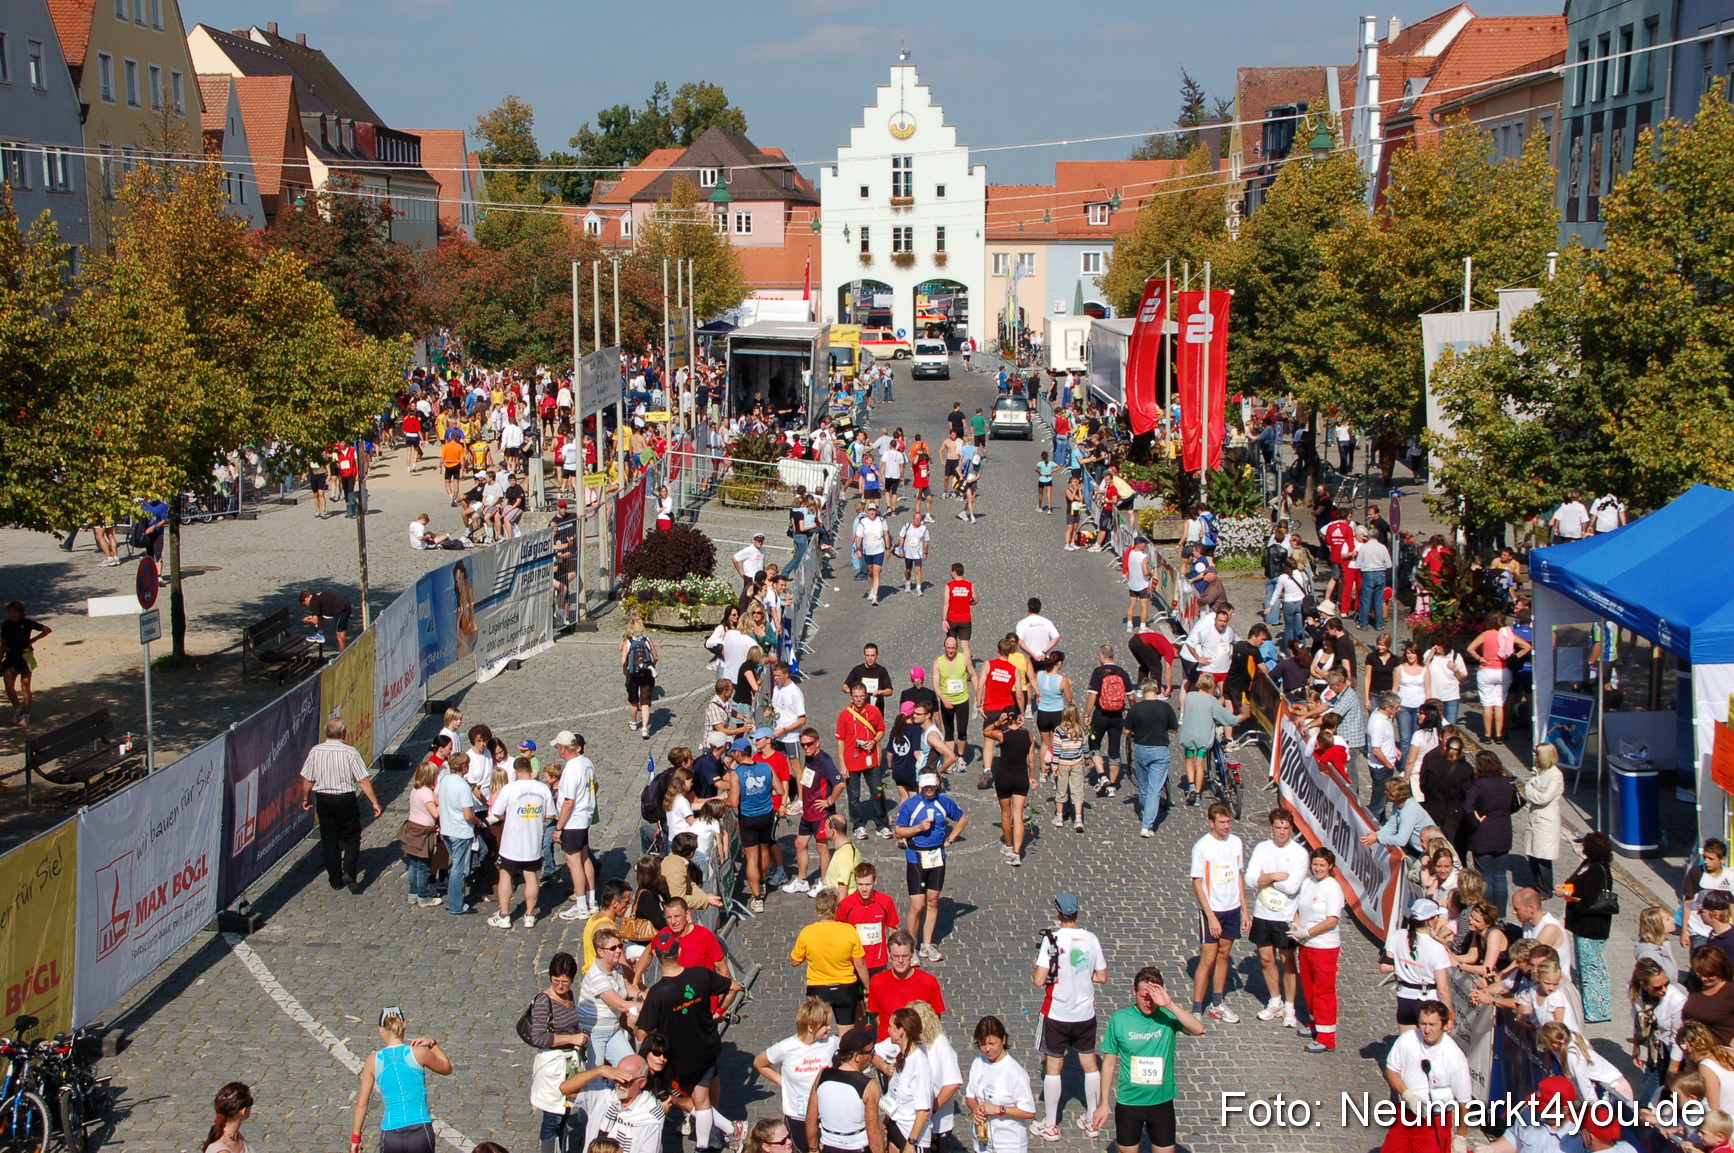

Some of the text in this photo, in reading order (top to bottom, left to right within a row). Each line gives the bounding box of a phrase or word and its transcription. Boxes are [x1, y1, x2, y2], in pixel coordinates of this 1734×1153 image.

[521, 540, 551, 560] Wagner
[136, 832, 149, 861] wir
[150, 805, 180, 844] bauen
[197, 759, 214, 796] Sie!
[517, 804, 543, 815] reindl
[1332, 810, 1351, 863] am
[36, 846, 63, 892] Sie!
[135, 854, 209, 928] MAX BÖGL
[1269, 898, 1282, 906] 460
[866, 932, 879, 940] 522
[5, 959, 61, 1018] BÖGL
[1128, 1029, 1162, 1041] Sinupret
[1139, 1058, 1155, 1066] Markus
[1142, 1068, 1158, 1077] 359
